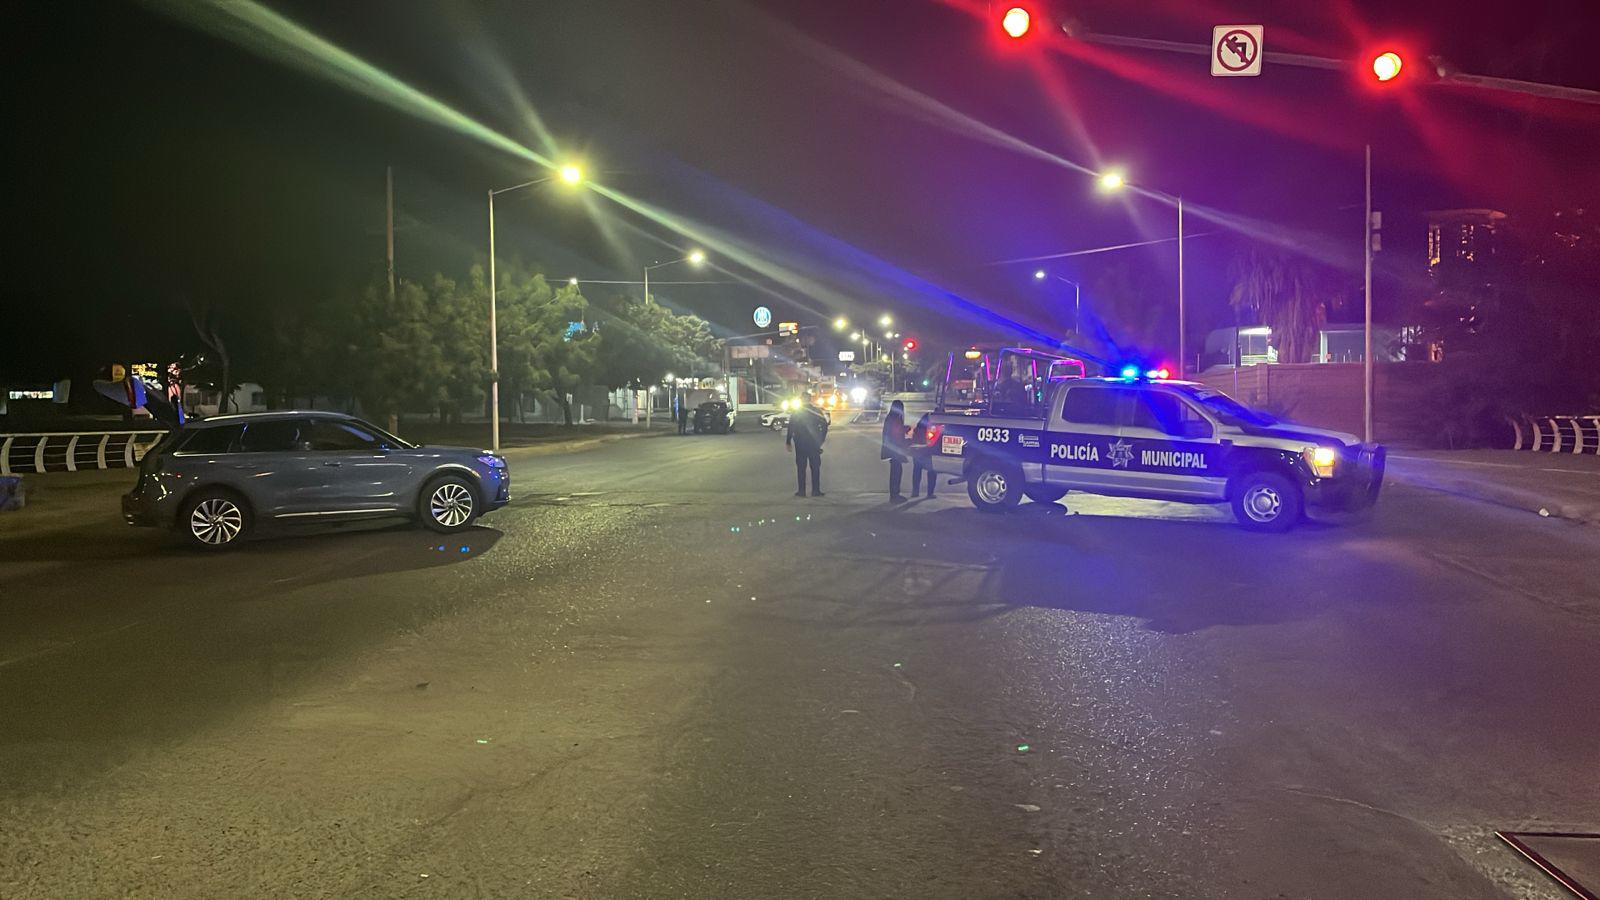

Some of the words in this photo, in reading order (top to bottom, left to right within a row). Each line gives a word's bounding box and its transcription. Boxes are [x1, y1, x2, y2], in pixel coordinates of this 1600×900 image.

[978, 428, 1010, 443] 0933
[1050, 443, 1099, 461] POLICÍA
[1141, 450, 1208, 469] MUNICIPAL
